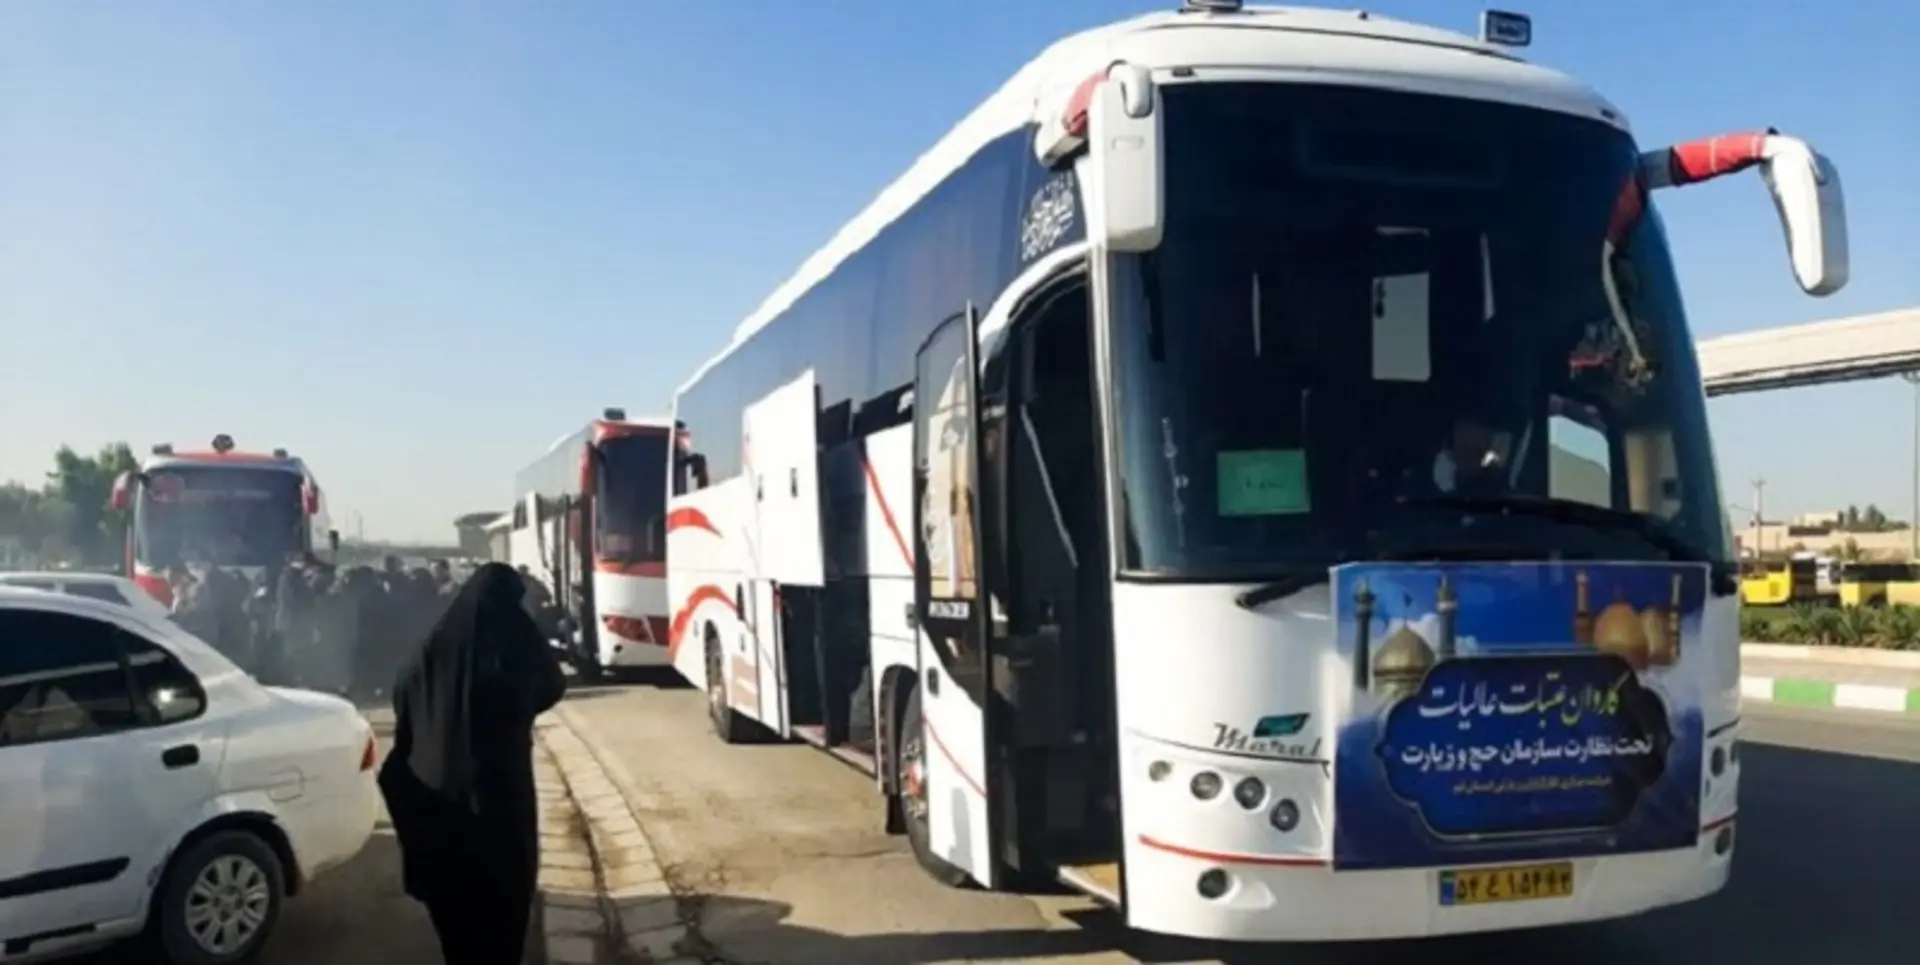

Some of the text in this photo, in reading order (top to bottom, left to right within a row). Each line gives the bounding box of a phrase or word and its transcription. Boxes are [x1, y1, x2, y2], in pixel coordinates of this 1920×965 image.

[1418, 679, 1498, 731] عالیات
[1562, 671, 1631, 726] کاروان
[1401, 733, 1654, 773] تحت نظارت سازمان حج و زیارت
